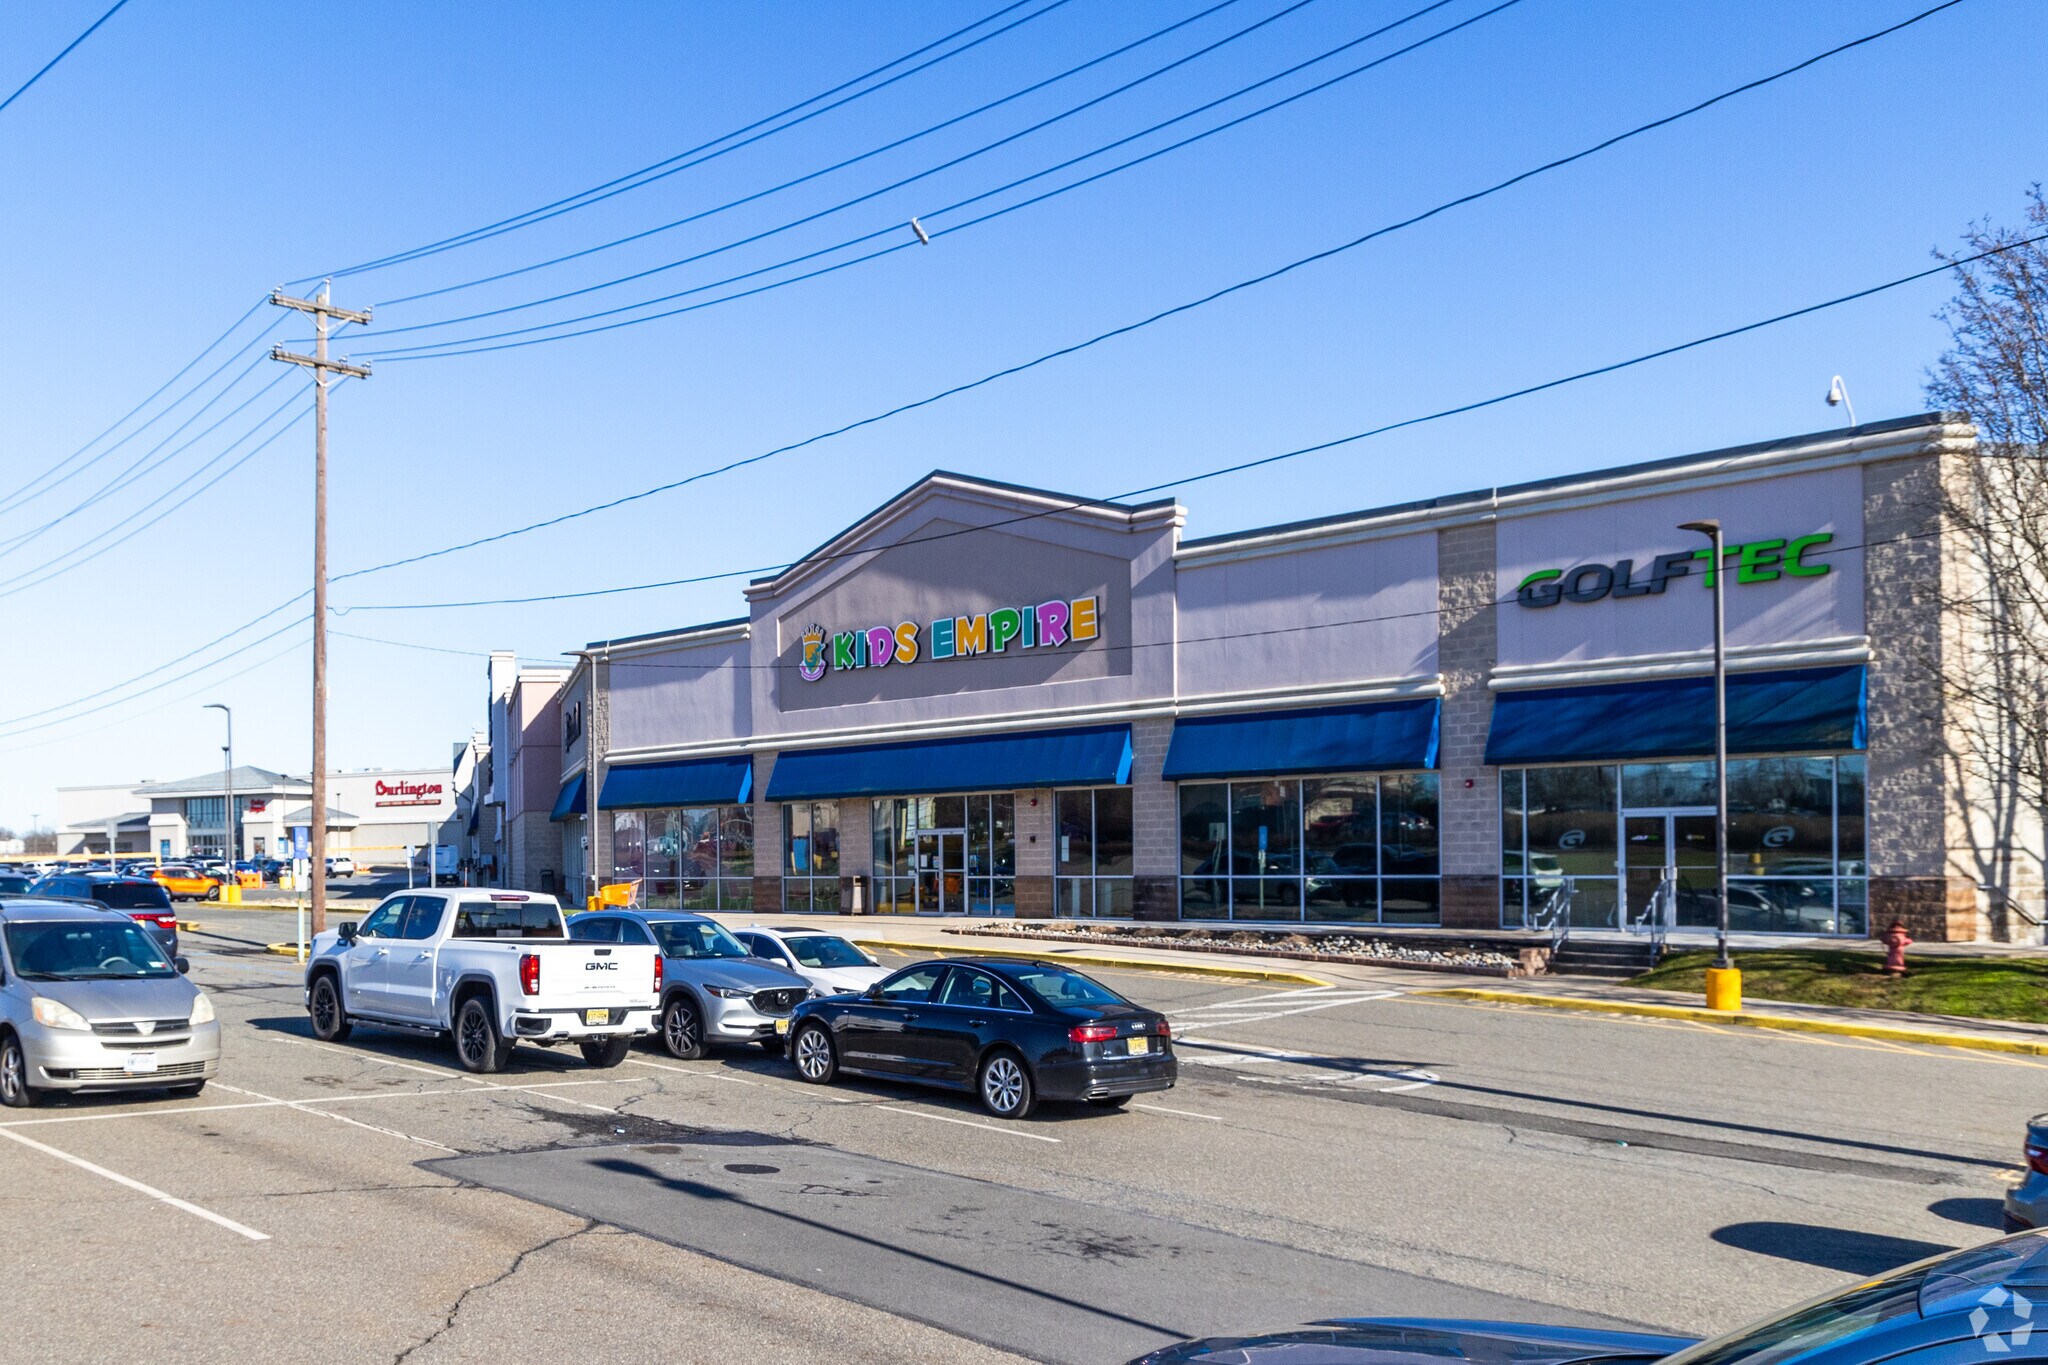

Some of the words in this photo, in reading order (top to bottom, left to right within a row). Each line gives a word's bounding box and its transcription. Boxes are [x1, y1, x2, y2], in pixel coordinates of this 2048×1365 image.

[1517, 533, 1833, 608] GOLFTEC
[833, 621, 919, 671] KIDS
[931, 596, 1099, 660] EMPIRE
[375, 780, 442, 799] Burlington
